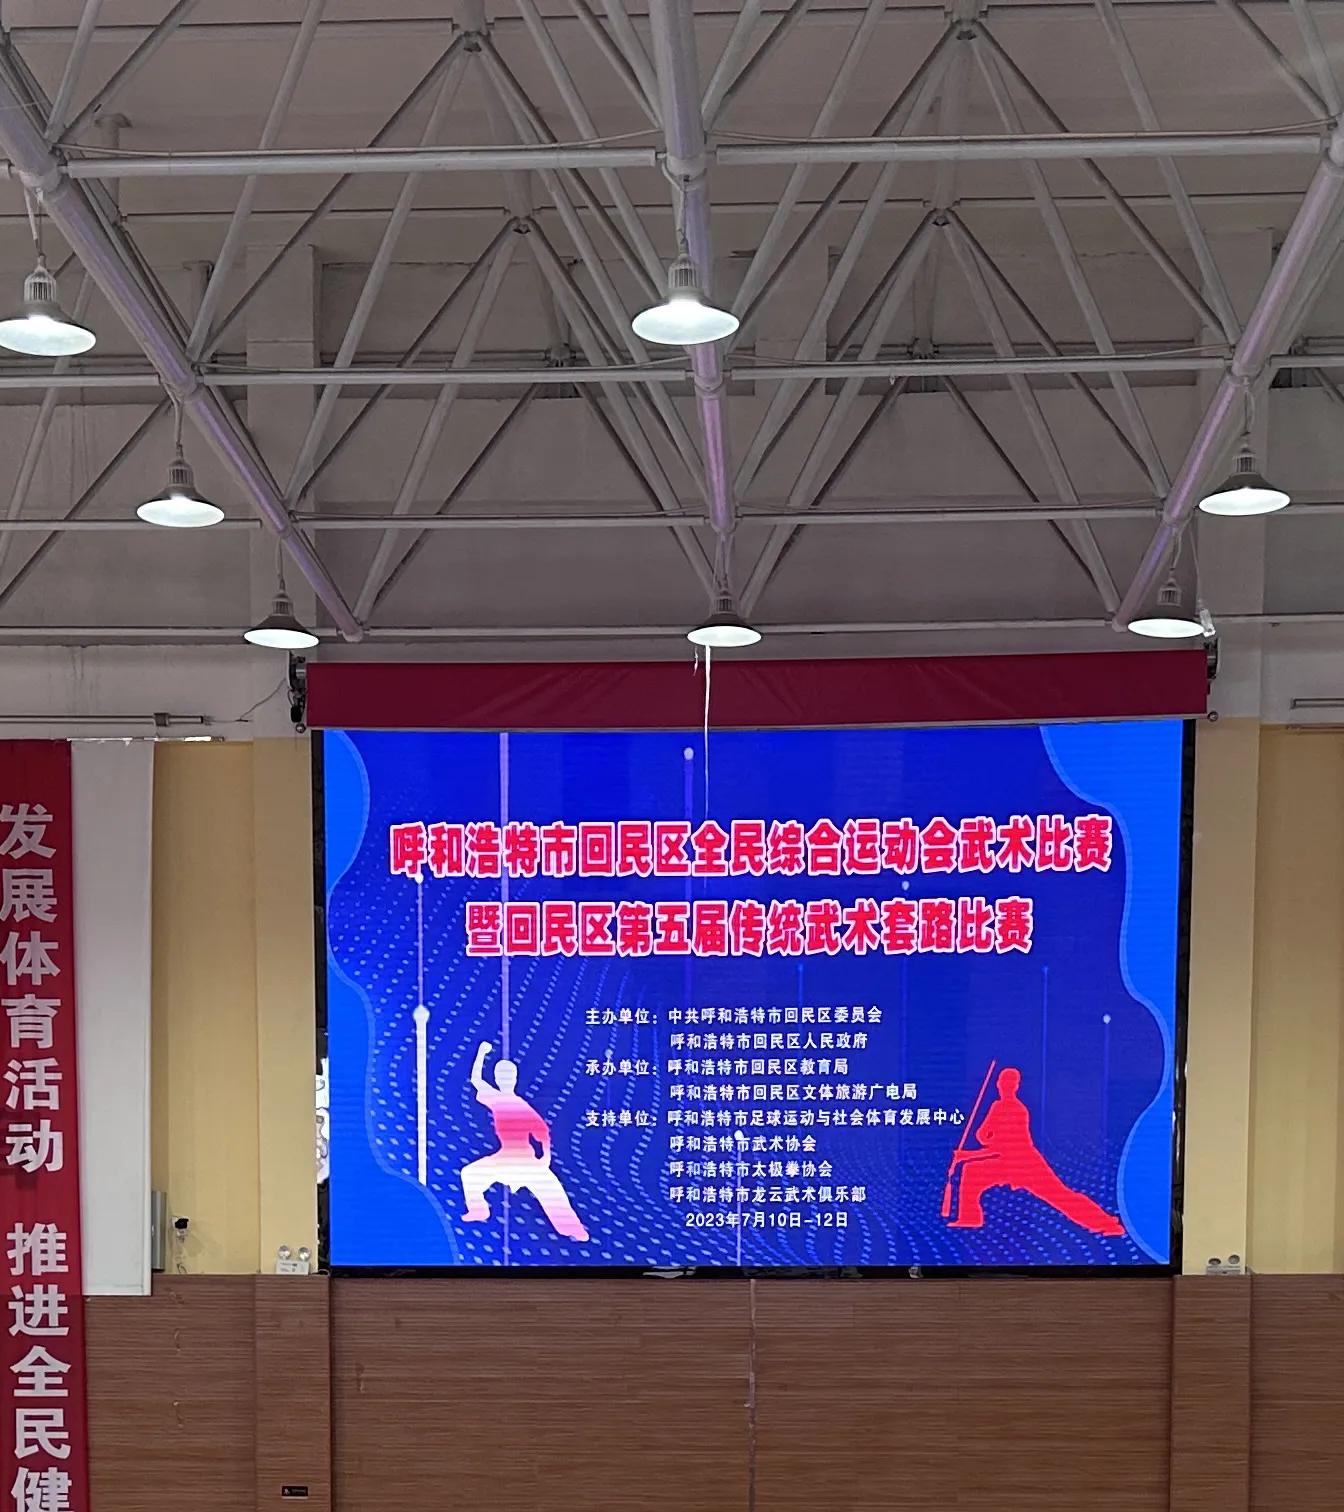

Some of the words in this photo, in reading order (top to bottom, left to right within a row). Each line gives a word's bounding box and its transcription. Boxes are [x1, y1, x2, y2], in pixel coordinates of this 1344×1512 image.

[391, 815, 1112, 877] 呼和浩特市回民区全民综合运动会武术比赛
[465, 898, 1033, 957] 暨回民区第五届传统武术套路比赛
[670, 1033, 868, 1050] 呼和浩特市回民区人民政府
[669, 1083, 918, 1101] 呼和浩特市回民区文体旅游广电局
[669, 1135, 817, 1153] 呼和浩特市武术协会
[669, 1160, 833, 1178] 呼和浩特市太极拳协会
[669, 1186, 866, 1204] 呼和浩特市龙云武术俱乐部
[685, 1211, 848, 1228] 2023年7月10日-12日
